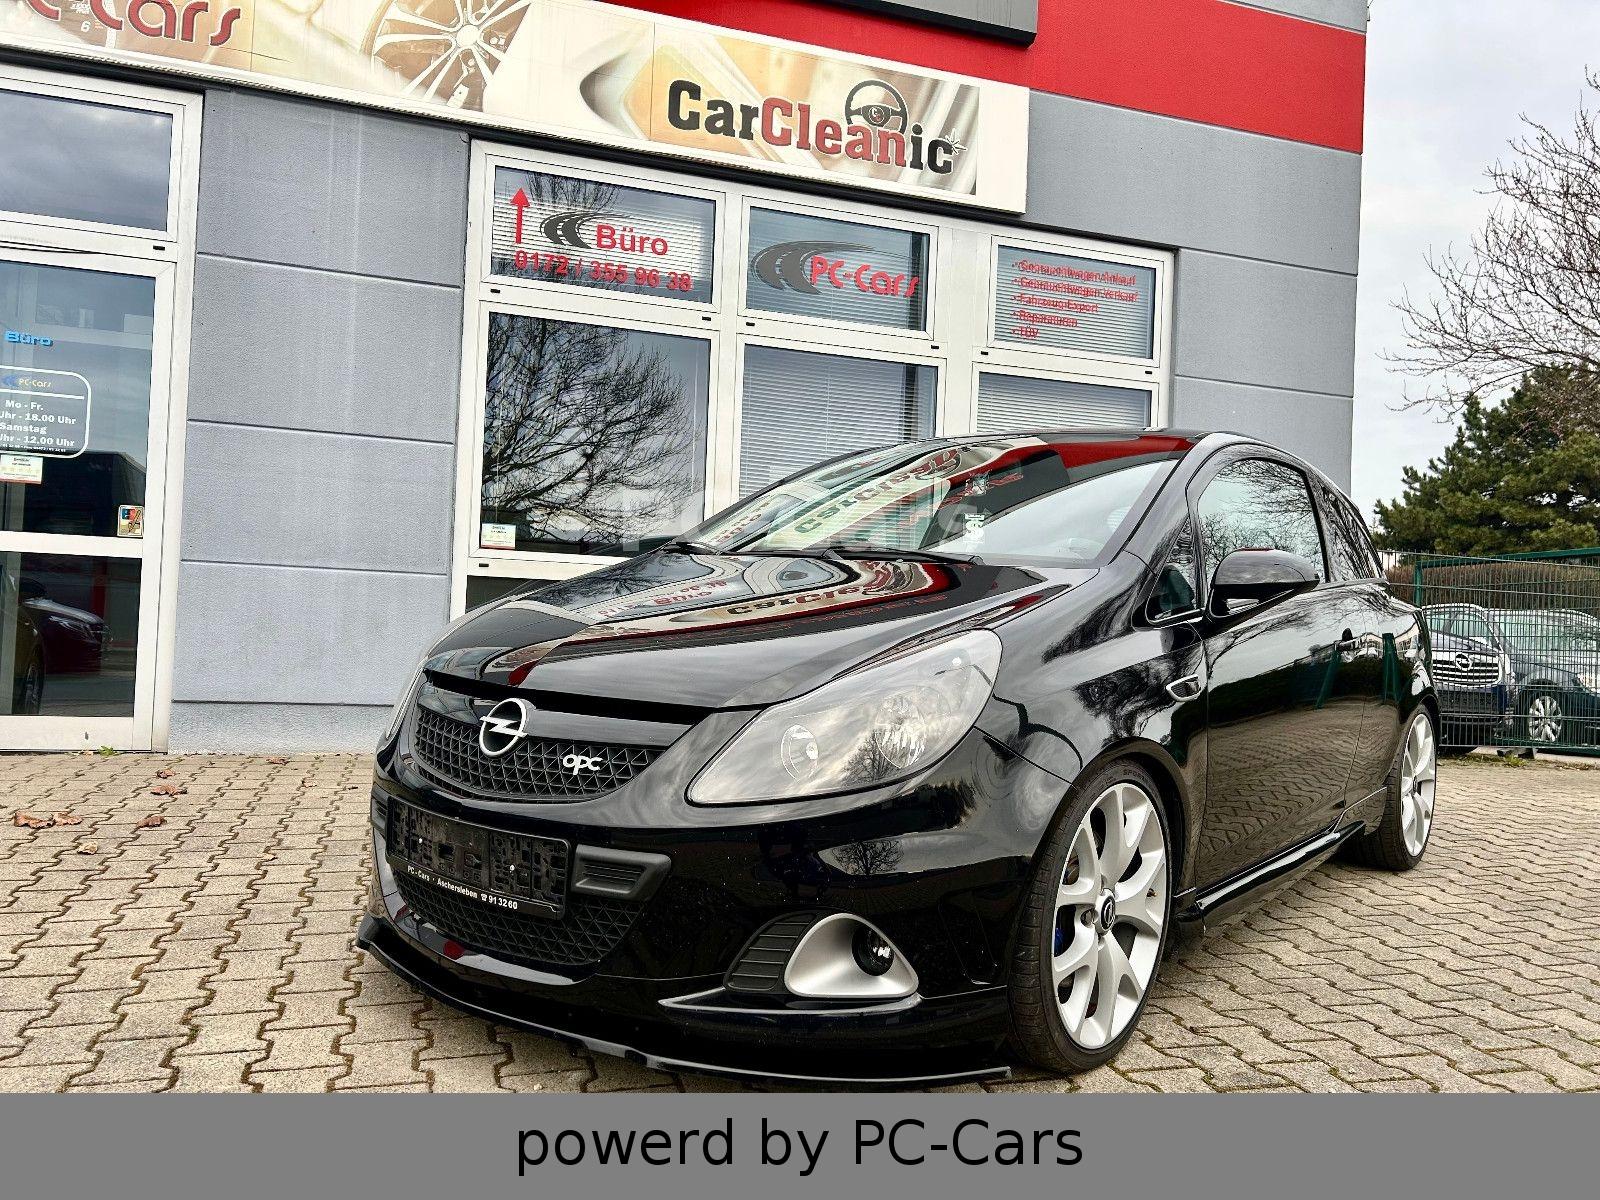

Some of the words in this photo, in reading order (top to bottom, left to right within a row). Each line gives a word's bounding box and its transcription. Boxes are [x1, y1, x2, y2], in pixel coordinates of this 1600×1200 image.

[667, 79, 954, 175] CarCleanic
[596, 223, 669, 256] Büro
[513, 250, 570, 277] 0172
[588, 260, 628, 283] 355
[634, 267, 661, 288] 96
[666, 271, 694, 292] 38
[810, 255, 920, 298] PC-Cars
[6, 330, 54, 347] Büro
[5, 399, 22, 409] Mo
[30, 401, 44, 411] Fr.
[25, 412, 55, 423] 18.00
[57, 415, 77, 425] Uhr
[0, 421, 48, 435] Samstag
[23, 435, 54, 446] 12.00
[56, 438, 75, 447] Uhr
